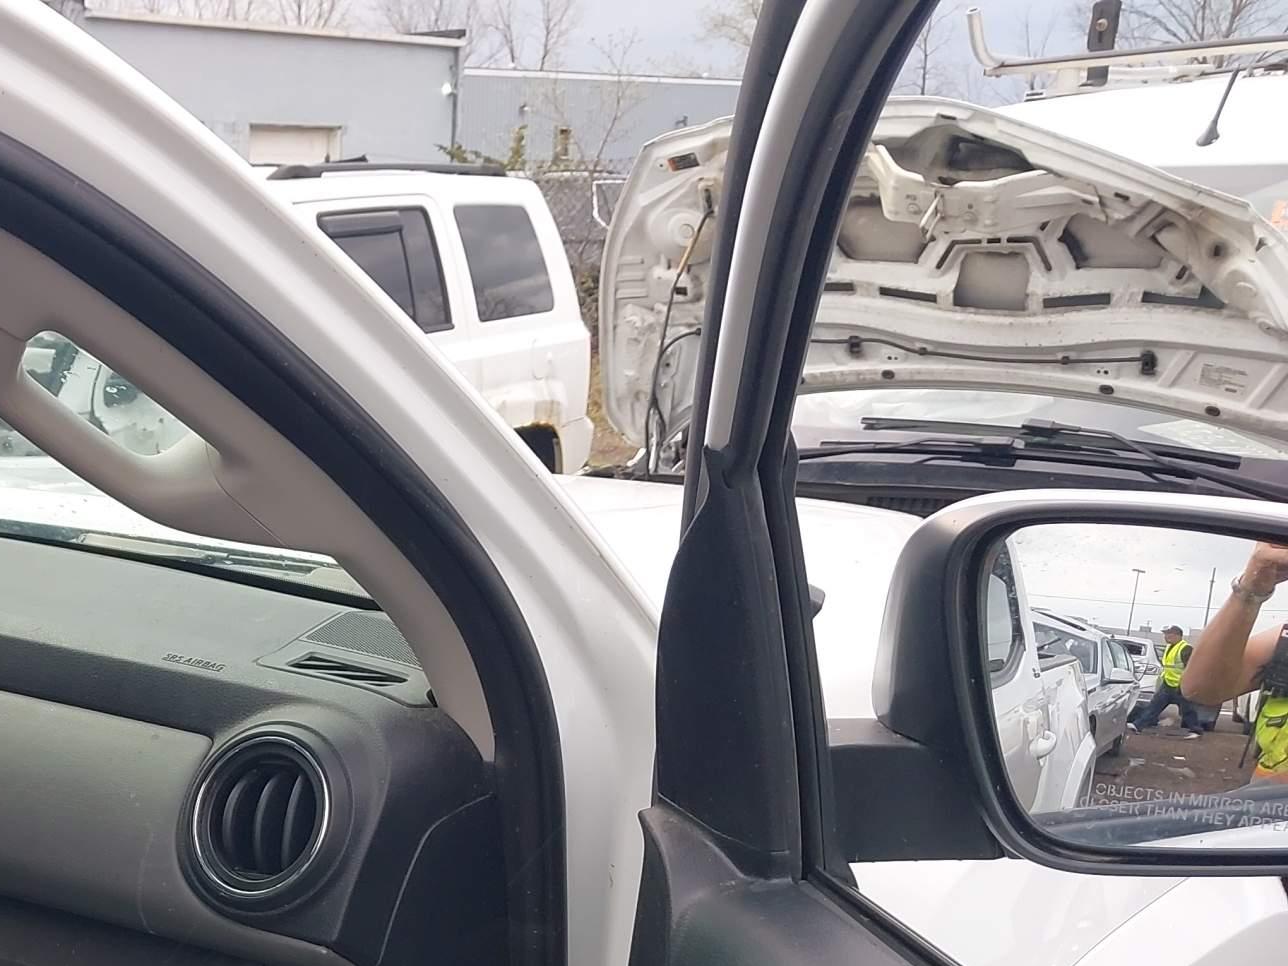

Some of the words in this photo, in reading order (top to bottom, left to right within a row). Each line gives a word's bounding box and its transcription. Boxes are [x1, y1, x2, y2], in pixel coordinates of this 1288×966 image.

[162, 652, 184, 663] SRS
[184, 657, 226, 672] AIRBAG
[1079, 796, 1140, 816] CLOSER
[1143, 803, 1188, 821] THAN
[1191, 809, 1235, 827] THEY
[1095, 783, 1163, 802] OBJECTS
[1168, 791, 1185, 805] IN
[1188, 793, 1255, 812] MIRROR
